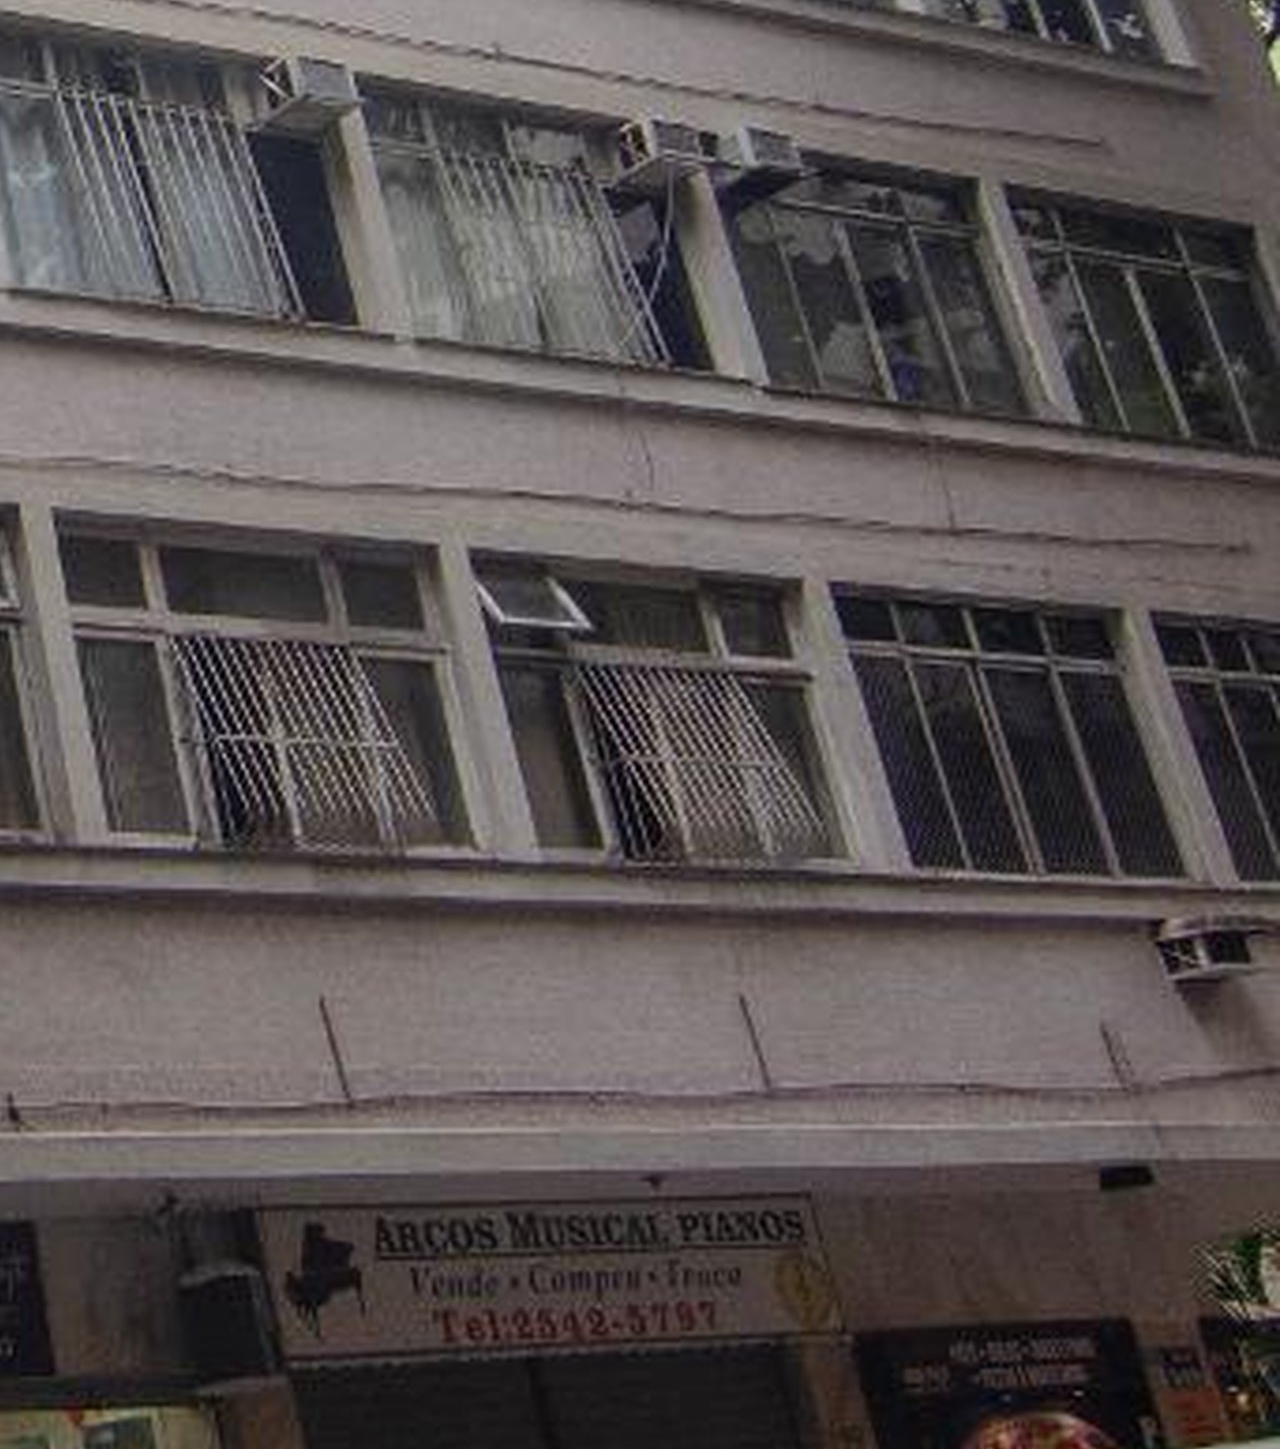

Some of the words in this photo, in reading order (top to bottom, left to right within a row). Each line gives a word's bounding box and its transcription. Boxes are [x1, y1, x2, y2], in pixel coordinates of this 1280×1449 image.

[374, 1215, 498, 1253] ARCOS
[506, 1211, 671, 1248] MUSICAL
[676, 1209, 804, 1242] PIANOS
